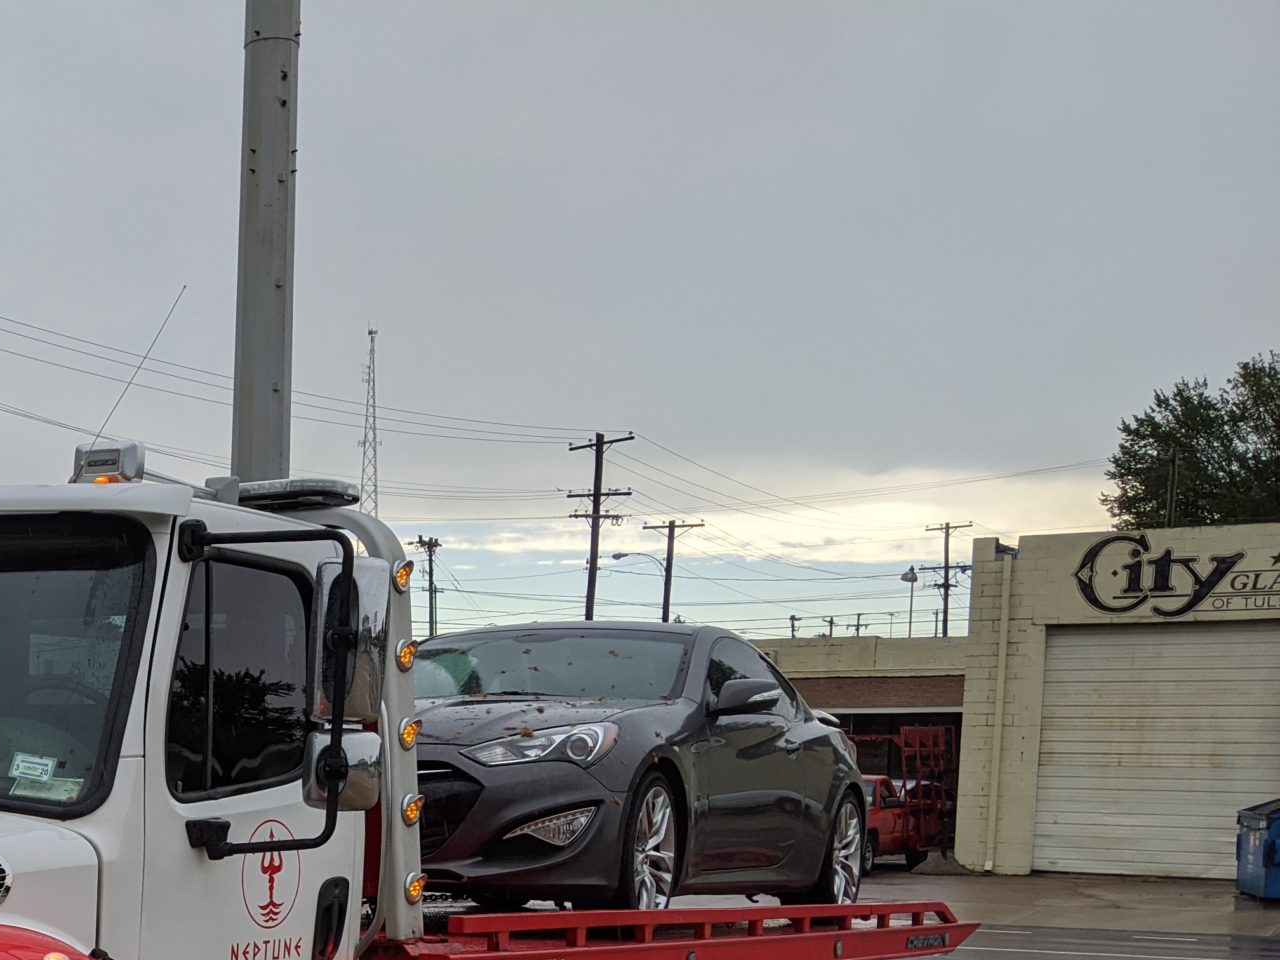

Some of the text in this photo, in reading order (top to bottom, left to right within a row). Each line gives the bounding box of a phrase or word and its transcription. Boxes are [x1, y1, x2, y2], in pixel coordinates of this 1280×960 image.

[1072, 532, 1246, 619] City
[1211, 596, 1280, 609] OF TUL
[39, 768, 49, 776] 20
